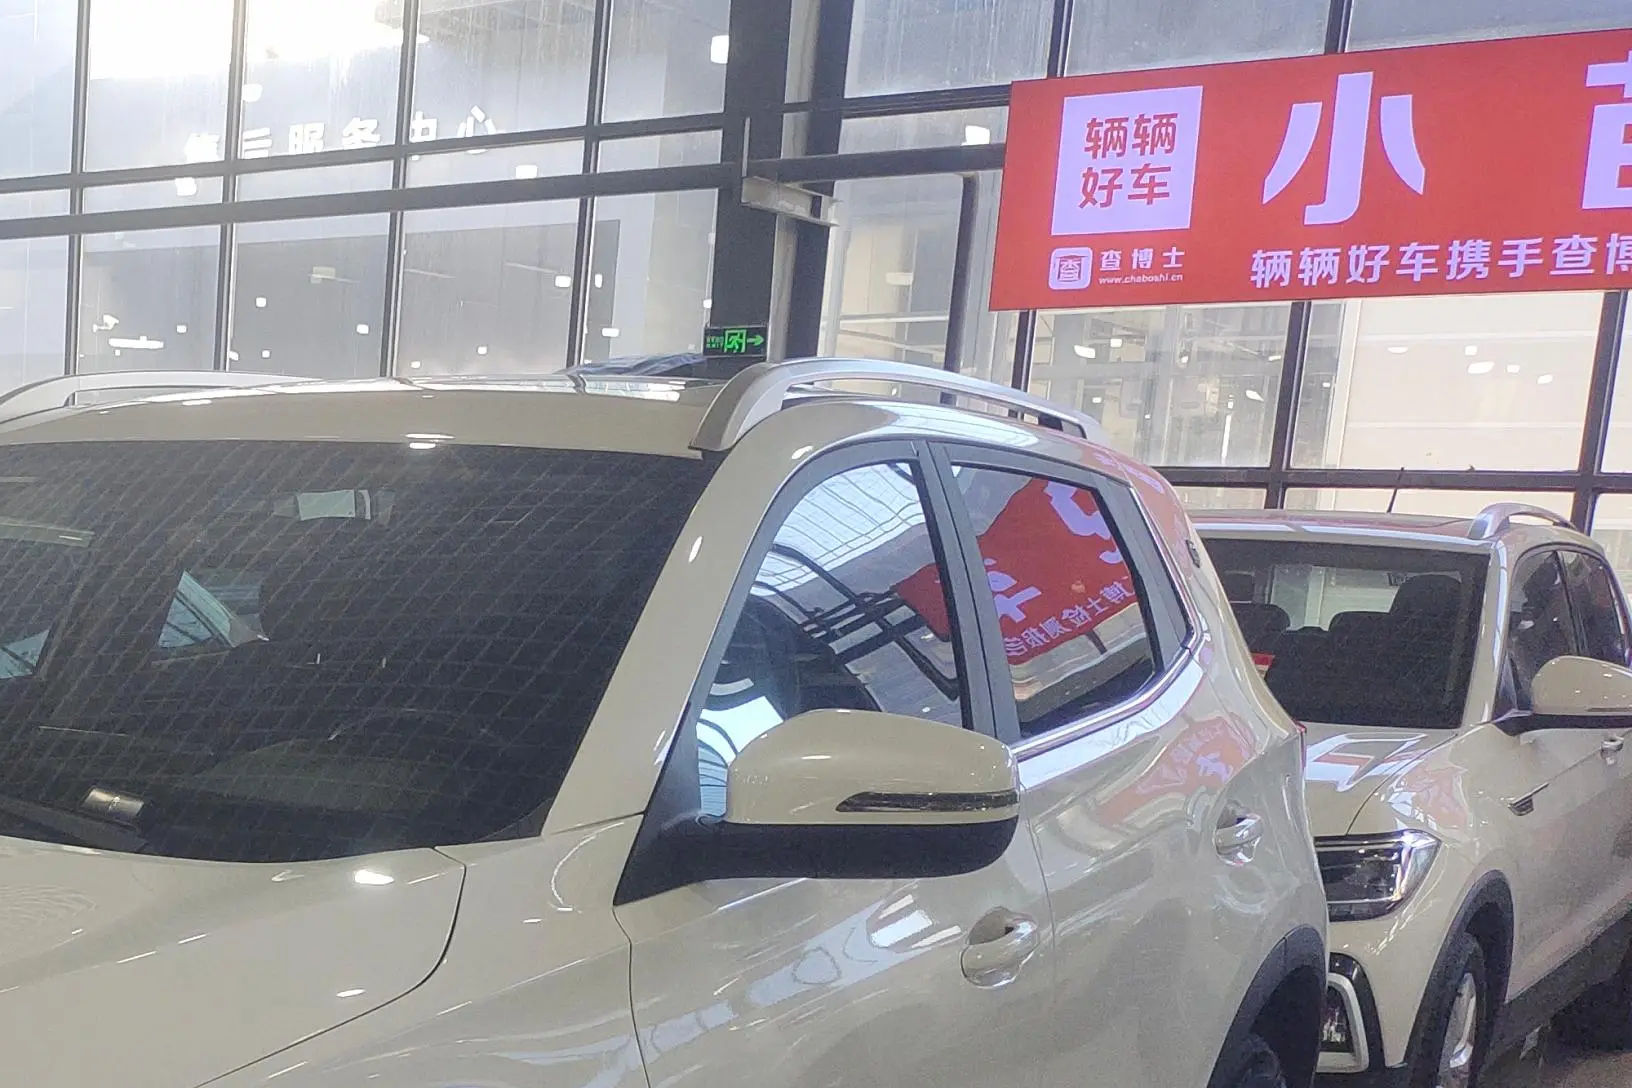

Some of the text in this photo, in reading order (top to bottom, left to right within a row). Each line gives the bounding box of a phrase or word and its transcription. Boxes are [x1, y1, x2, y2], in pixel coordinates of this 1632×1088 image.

[1082, 112, 1178, 161] 辆辆
[1078, 163, 1172, 210] 好车
[1099, 246, 1185, 272] 查博士
